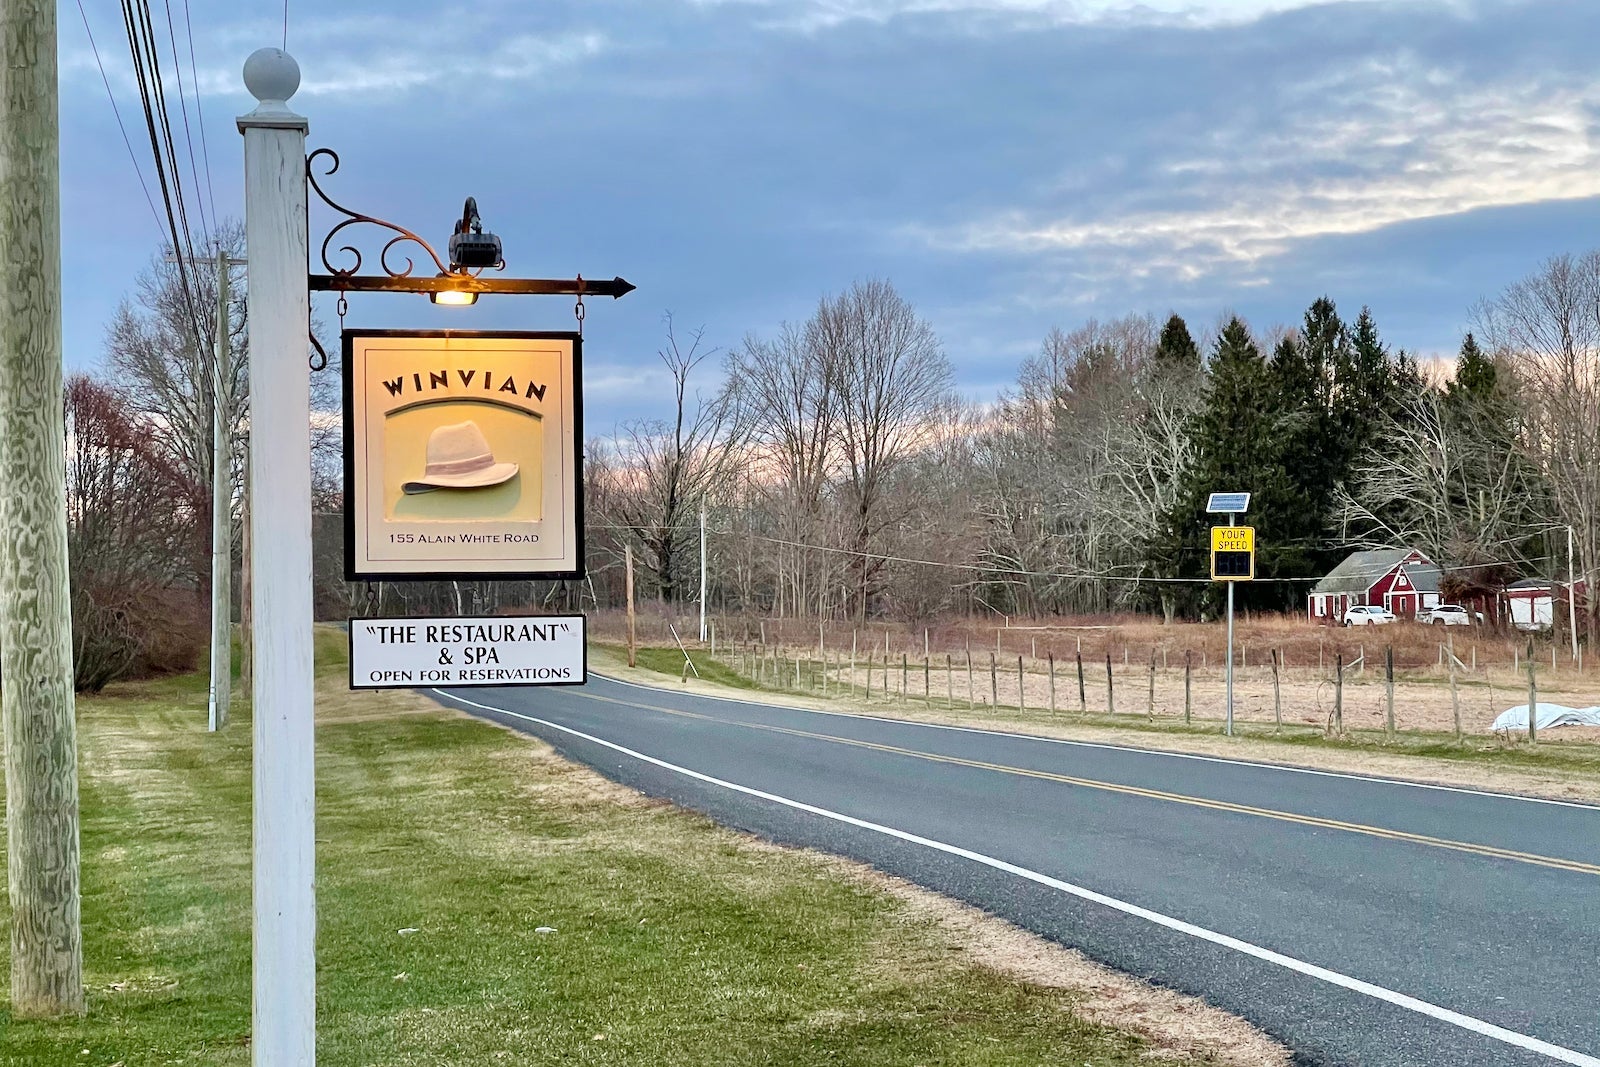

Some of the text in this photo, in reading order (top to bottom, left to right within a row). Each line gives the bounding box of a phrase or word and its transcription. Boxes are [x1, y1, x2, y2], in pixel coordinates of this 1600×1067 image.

[383, 370, 546, 402] WINVIAN
[389, 533, 414, 543] 155
[1221, 530, 1245, 538] YOUR
[1218, 541, 1247, 549] SPEED
[438, 647, 500, 665] & SPA
[370, 667, 571, 682] OPEN FOR RESERVATIONS
